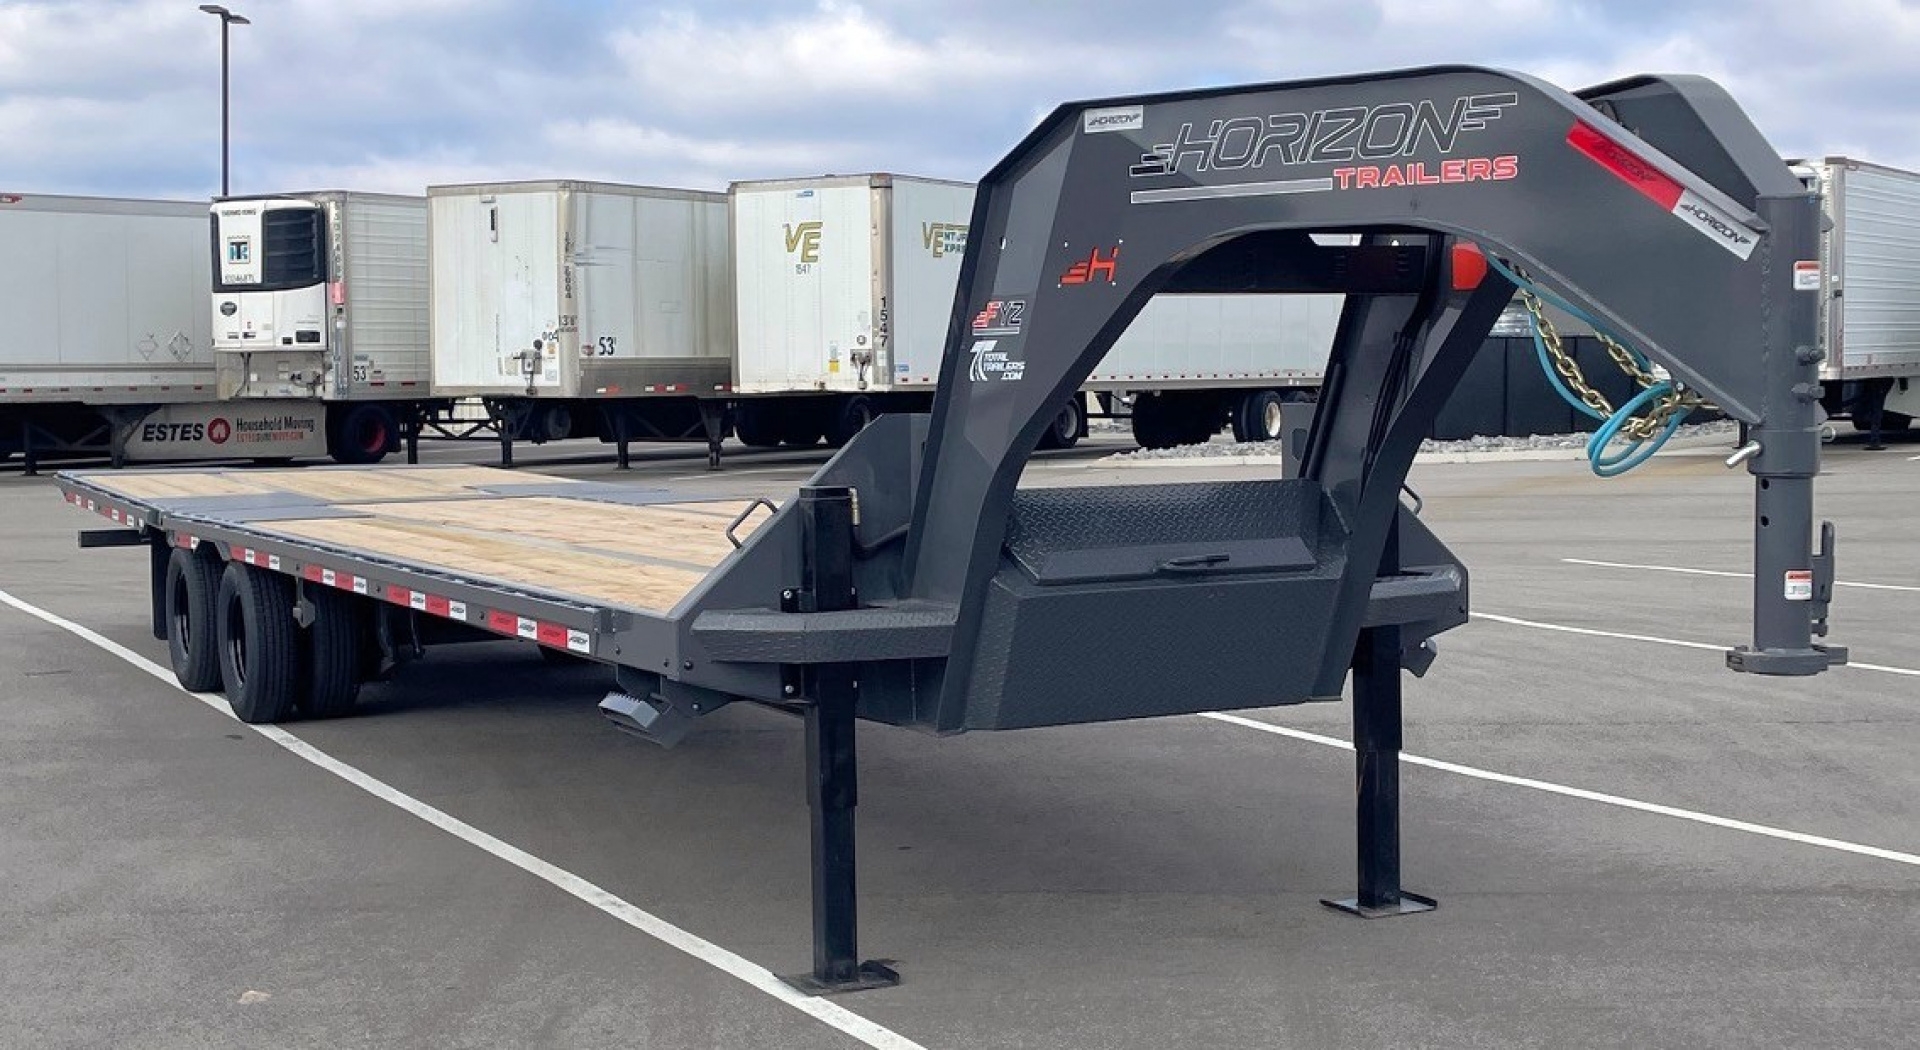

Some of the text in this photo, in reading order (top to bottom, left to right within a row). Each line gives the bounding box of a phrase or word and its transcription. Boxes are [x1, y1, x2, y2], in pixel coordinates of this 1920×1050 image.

[1090, 113, 1140, 126] HORIZON
[1165, 95, 1469, 176] HORIZON
[1333, 155, 1518, 190] TRAILERS
[1683, 204, 1750, 244] HORIZON
[784, 222, 823, 262] VE
[984, 353, 1008, 361] TOTAL
[984, 362, 1025, 371] TRAILERS
[142, 423, 204, 442] ESTES
[236, 416, 314, 432] Household Moving
